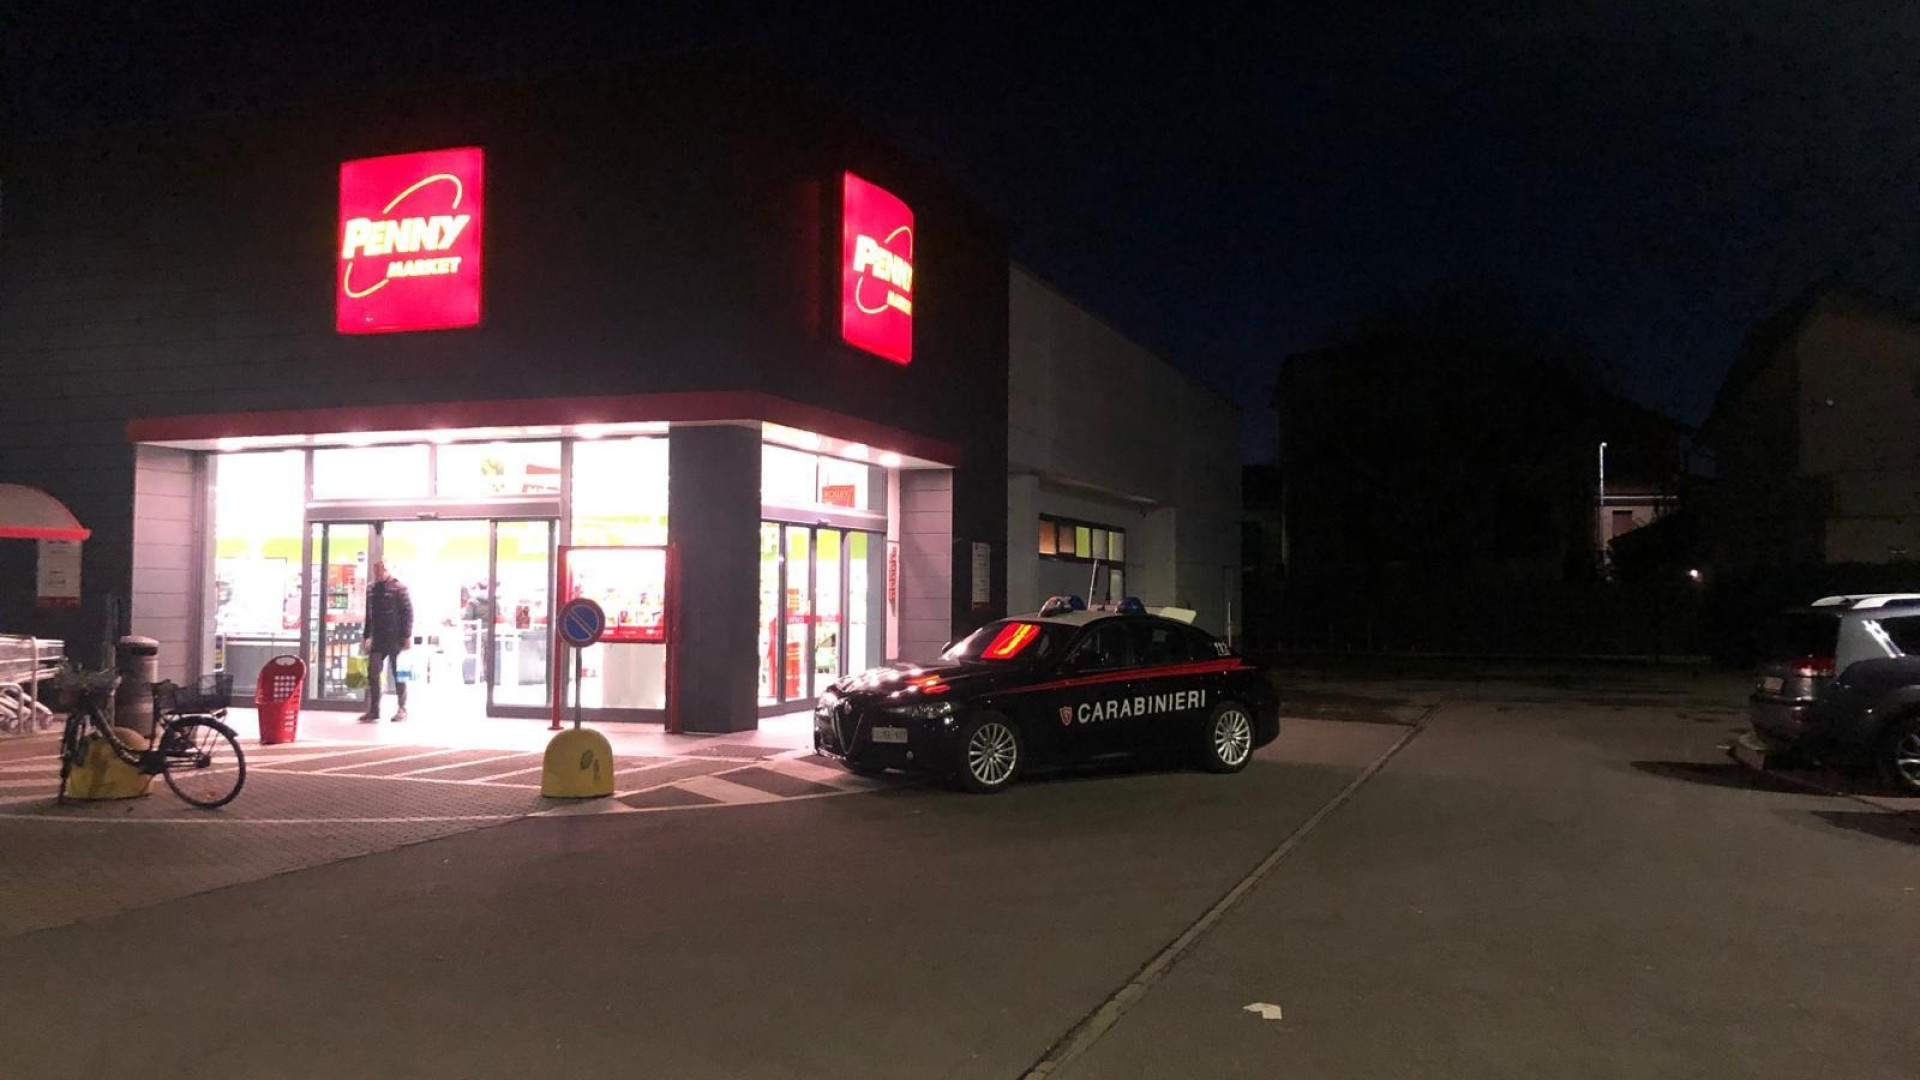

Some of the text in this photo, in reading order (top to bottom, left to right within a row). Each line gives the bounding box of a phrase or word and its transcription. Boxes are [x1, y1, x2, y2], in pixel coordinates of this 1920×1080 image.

[342, 214, 471, 259] PENNY
[386, 256, 462, 278] MARKET
[1077, 689, 1206, 724] CARABINIERI
